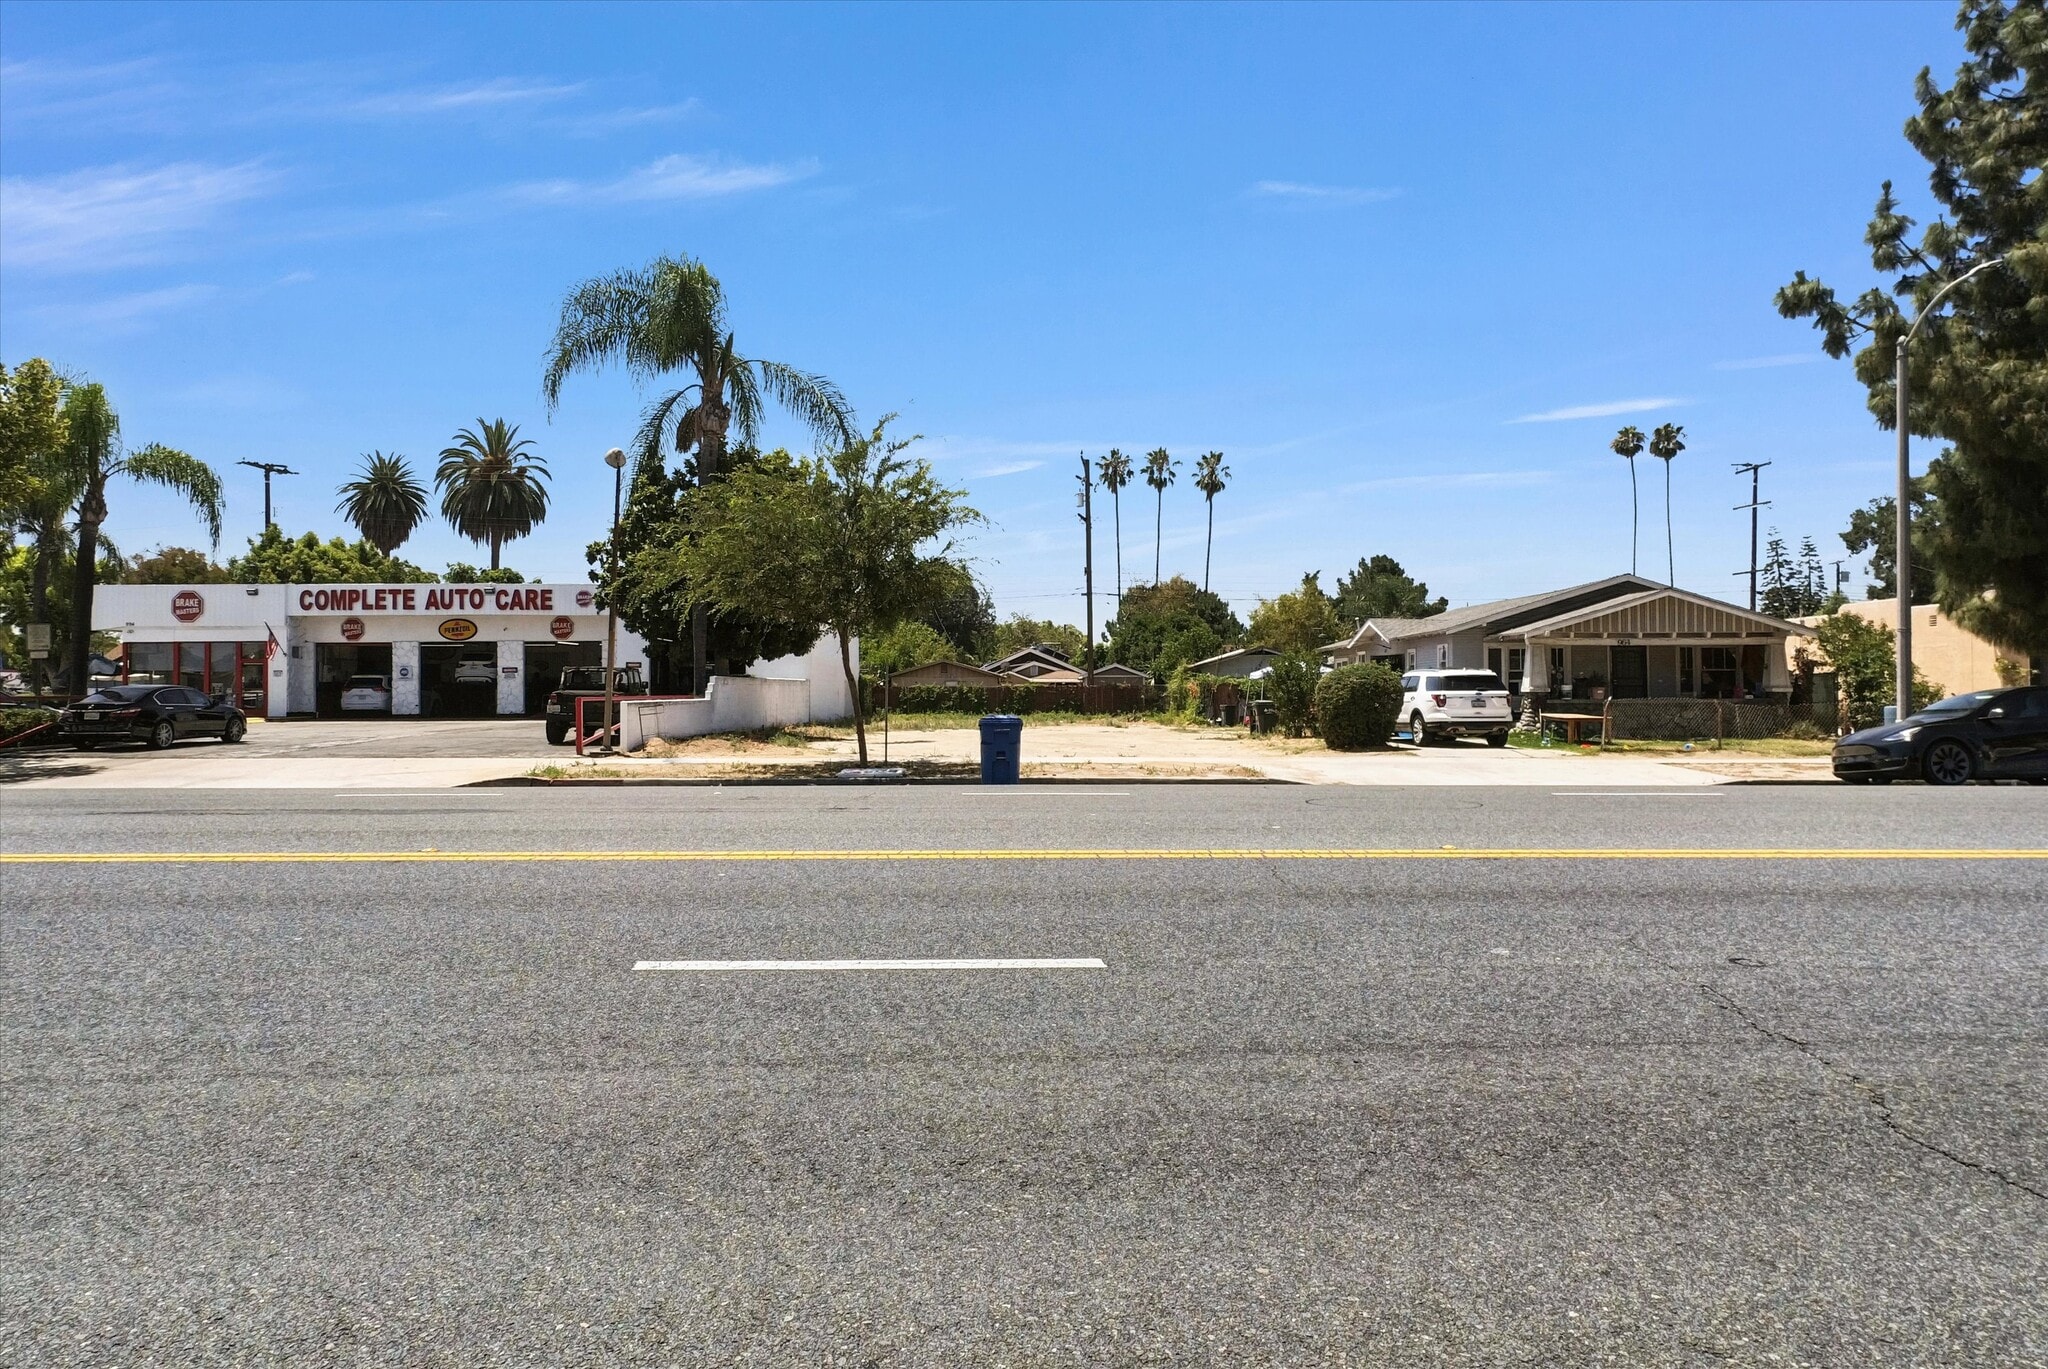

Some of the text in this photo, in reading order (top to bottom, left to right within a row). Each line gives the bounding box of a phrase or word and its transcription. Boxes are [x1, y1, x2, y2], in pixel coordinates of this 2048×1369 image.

[175, 598, 199, 607] BRAKE
[299, 589, 553, 611] COMPLETE AUTO CARE
